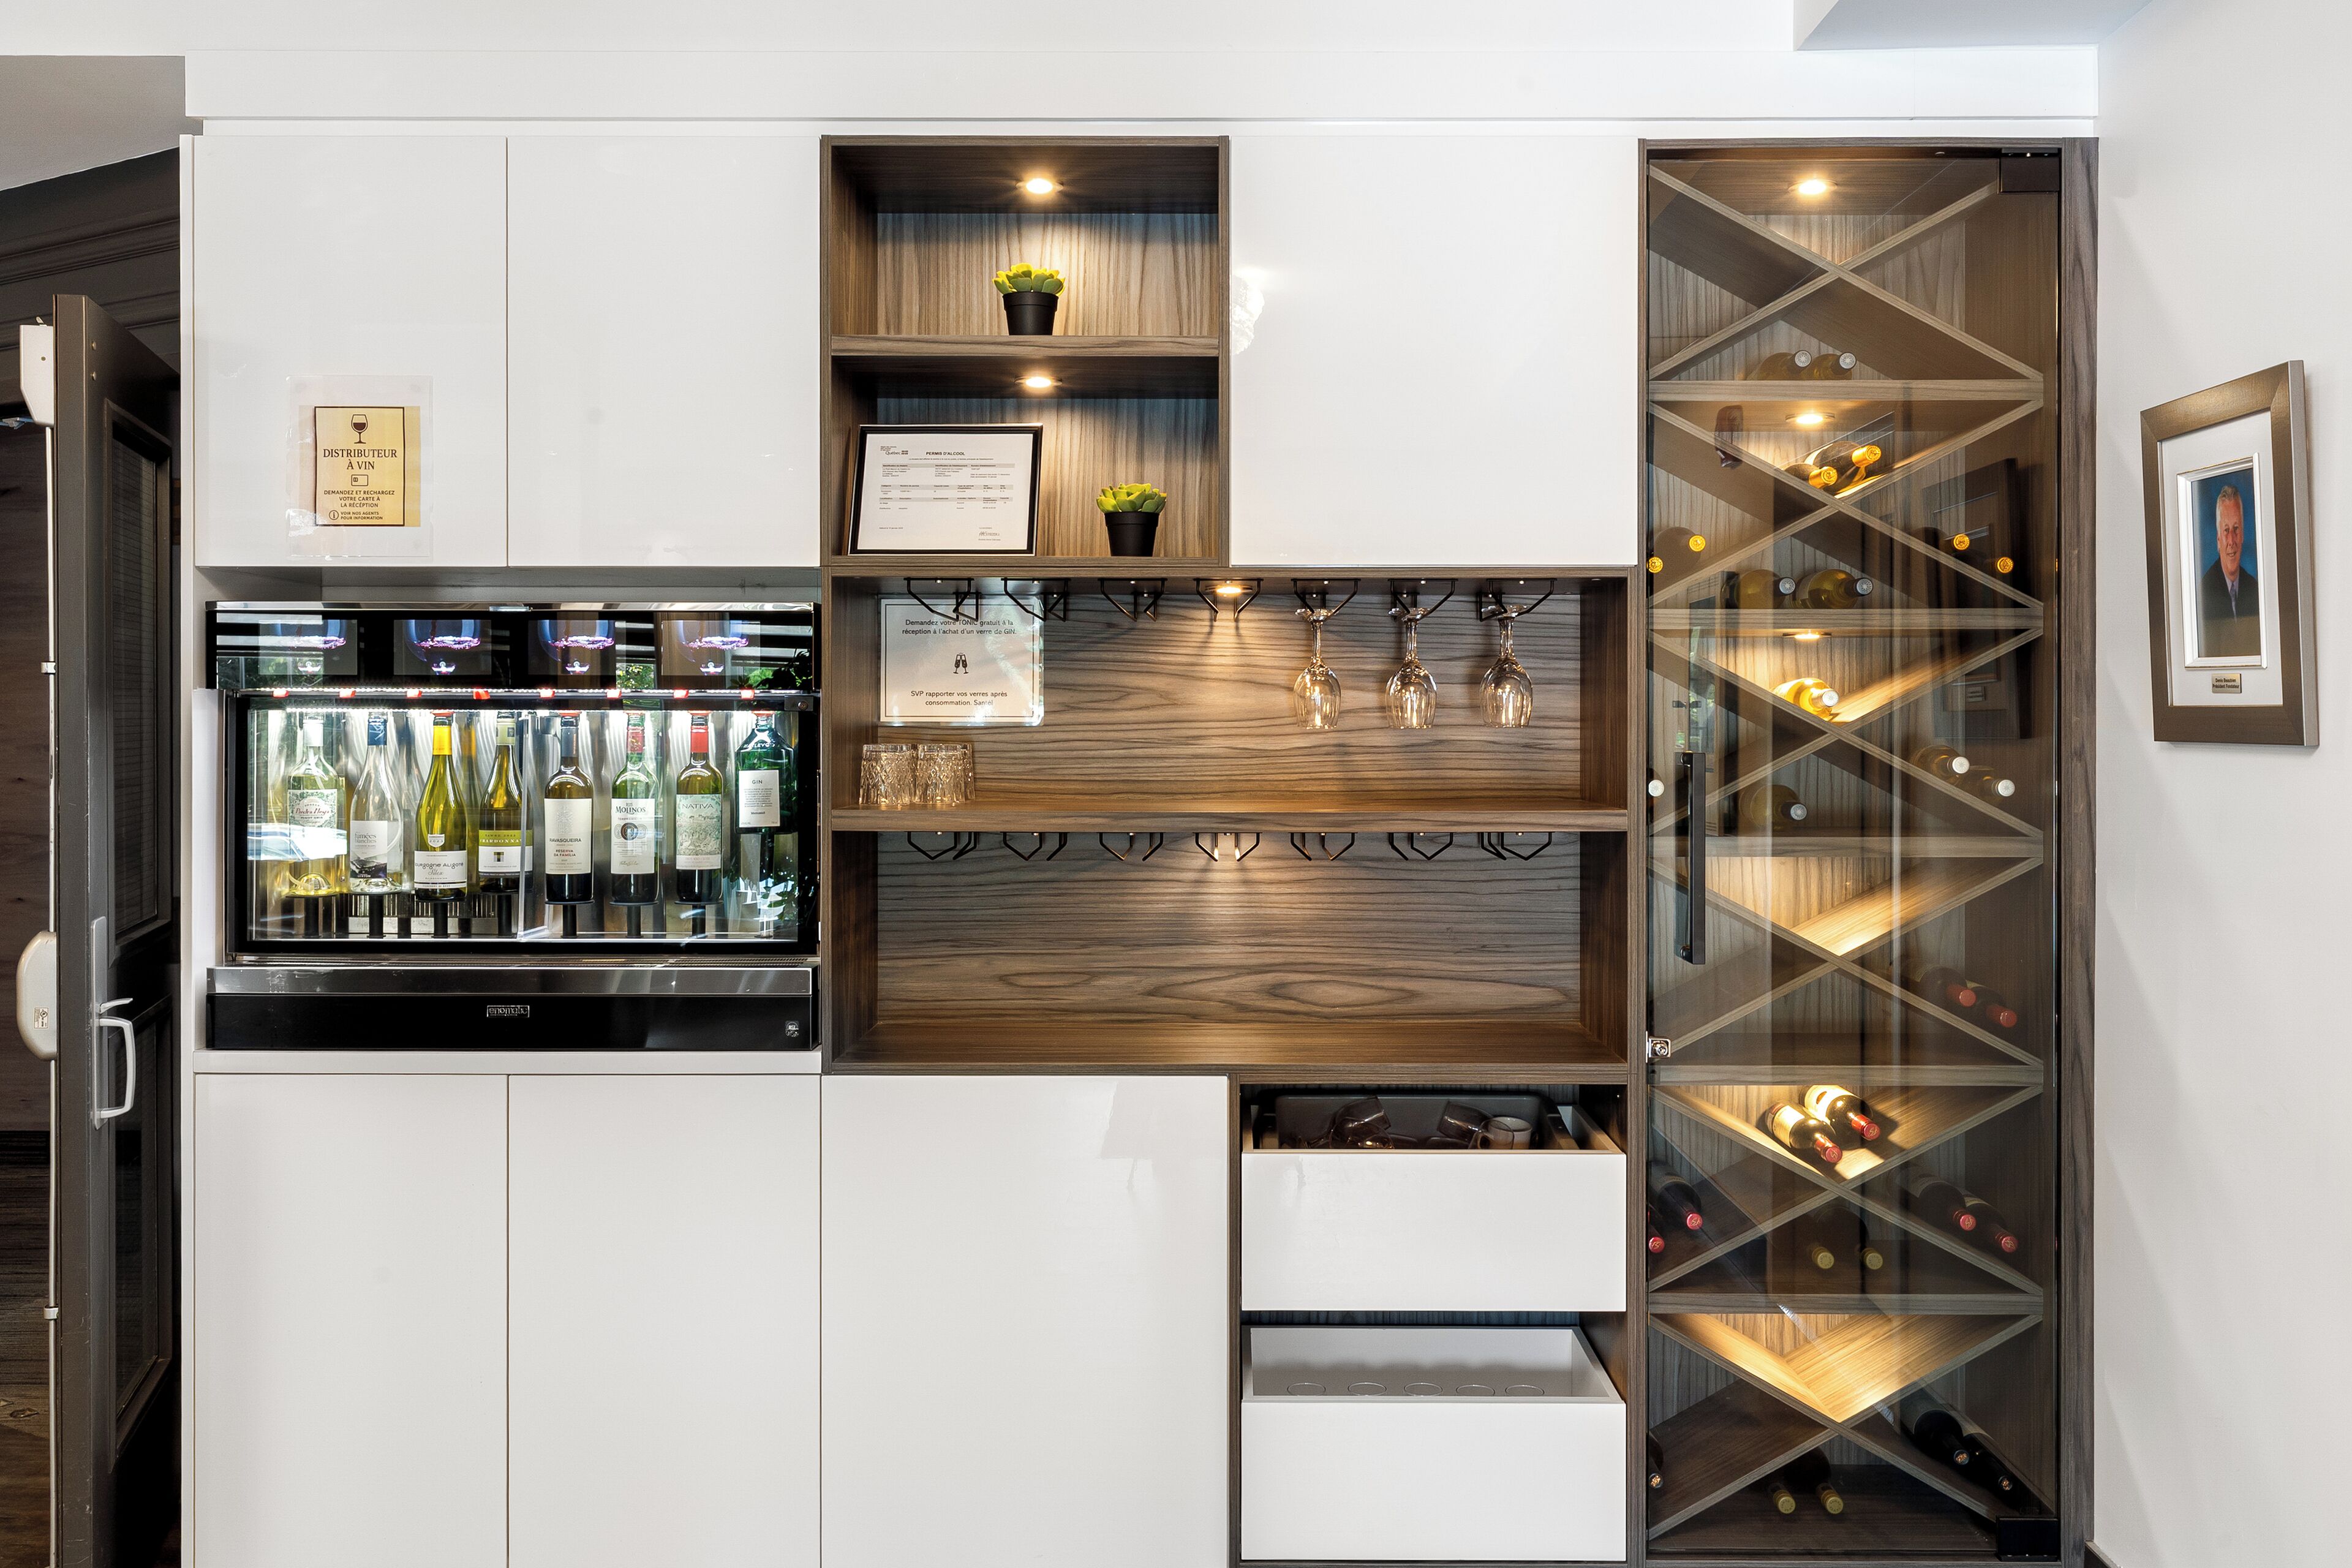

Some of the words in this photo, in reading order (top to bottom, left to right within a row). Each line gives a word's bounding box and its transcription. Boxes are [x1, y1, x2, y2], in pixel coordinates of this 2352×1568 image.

[323, 448, 398, 458] DISTRIBUTEUR
[347, 459, 354, 470] À
[356, 461, 375, 470] VIN
[615, 805, 646, 815] MOLINOS
